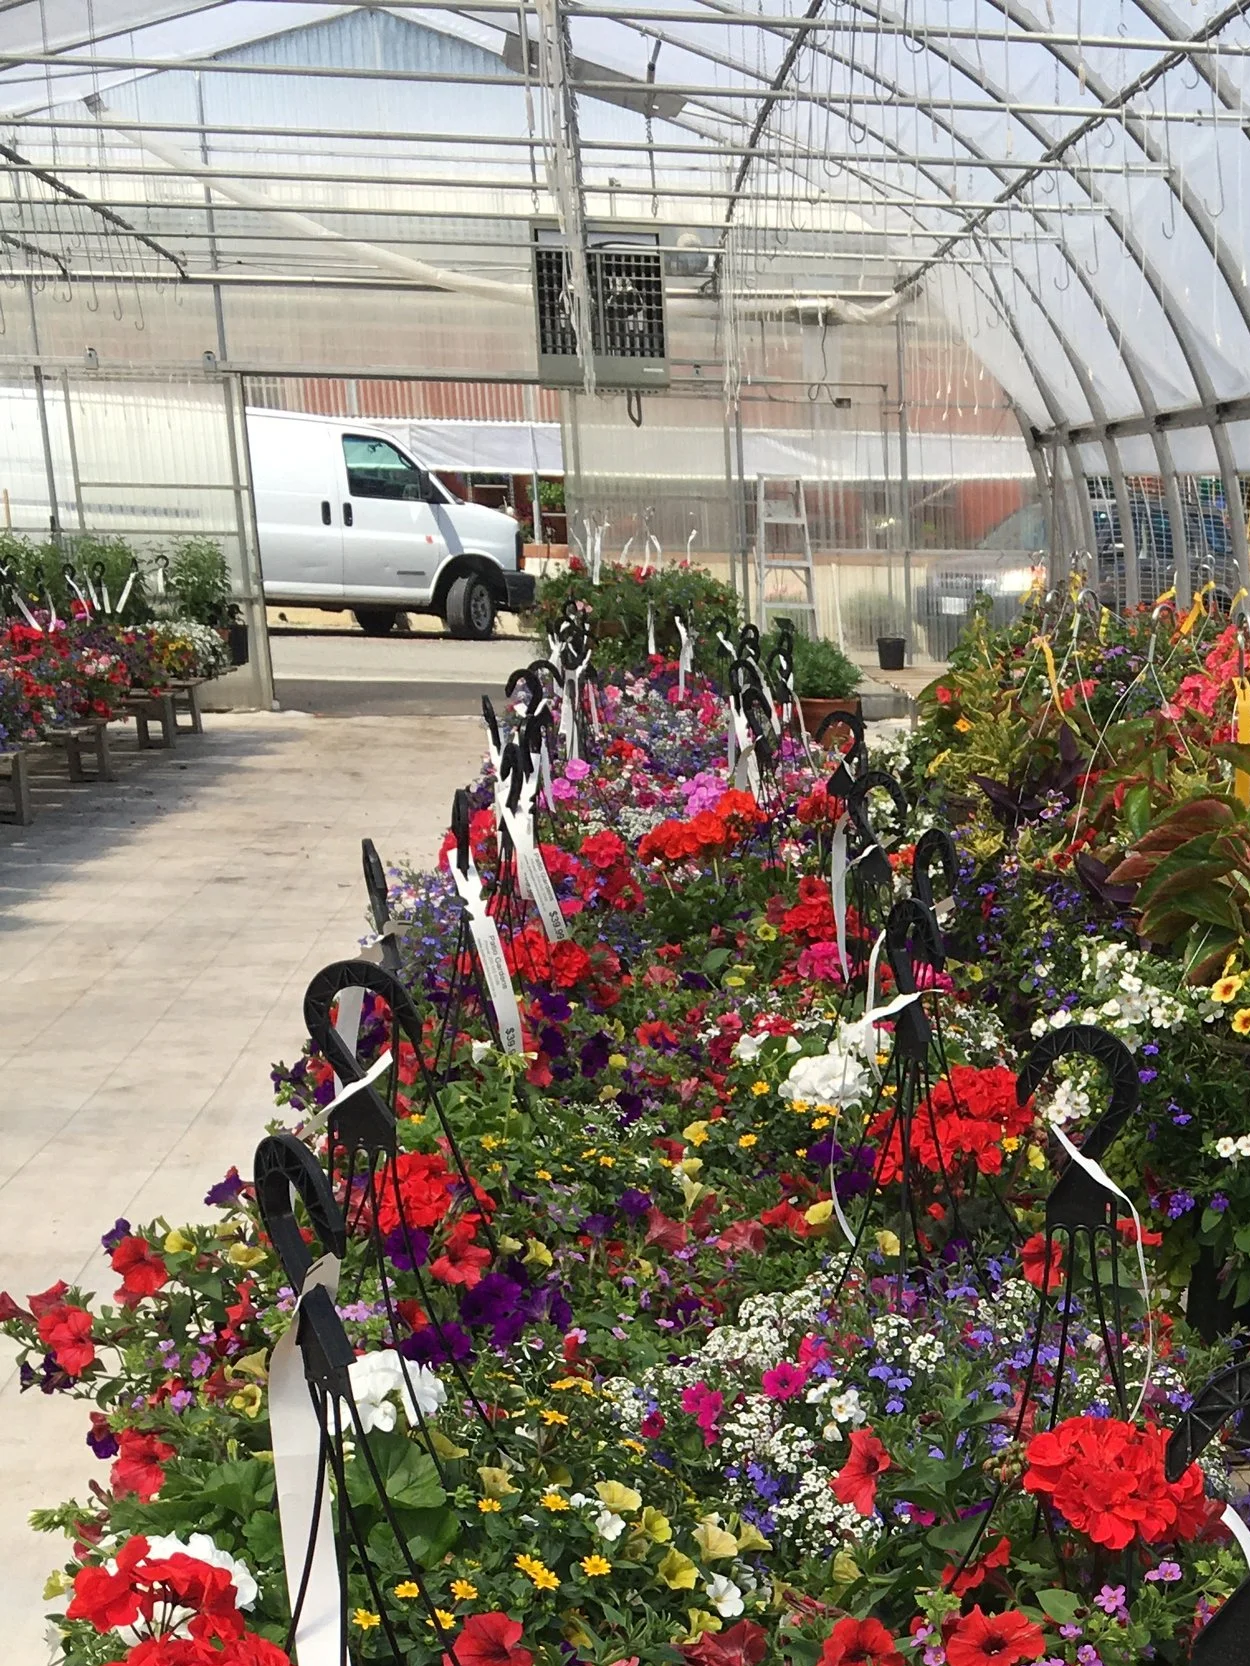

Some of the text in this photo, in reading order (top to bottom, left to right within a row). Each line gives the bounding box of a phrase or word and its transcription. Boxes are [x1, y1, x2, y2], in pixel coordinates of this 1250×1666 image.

[549, 911, 565, 940] $39.99
[488, 935, 499, 956] Patio
[493, 956, 508, 990] Gardens
[504, 1028, 516, 1056] $39.9
